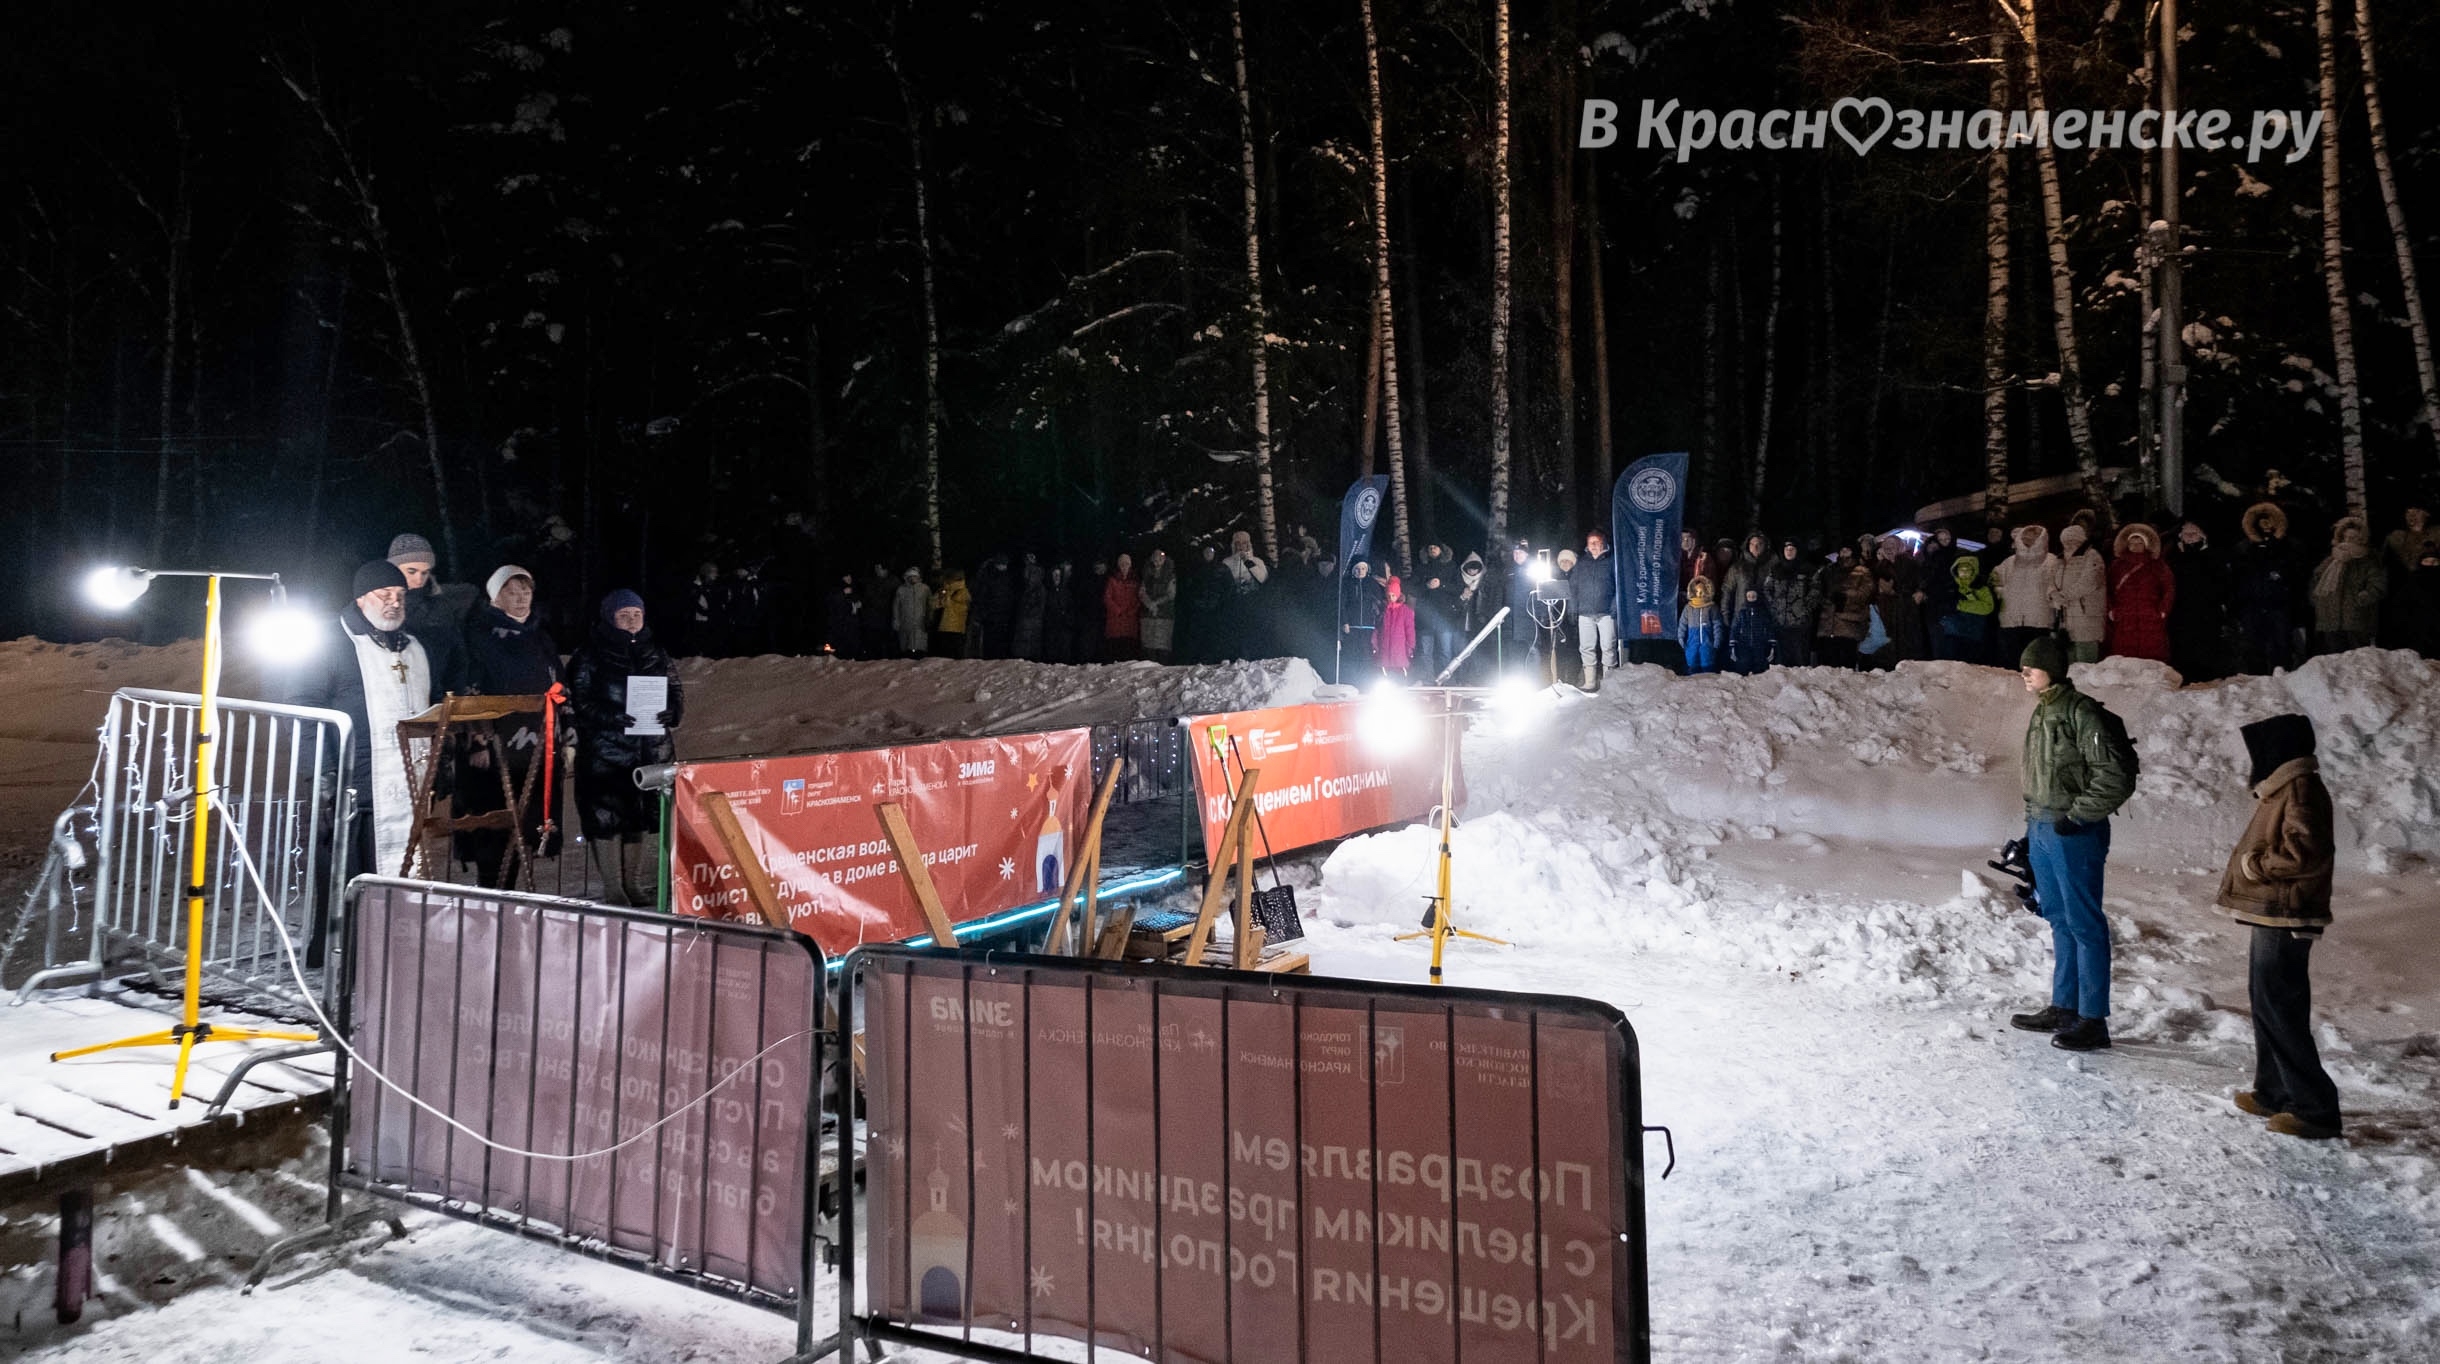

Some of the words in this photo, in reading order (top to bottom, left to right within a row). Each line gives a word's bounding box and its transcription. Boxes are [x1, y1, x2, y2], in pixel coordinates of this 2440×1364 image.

[1636, 582, 1649, 604] Клуб
[1217, 784, 1312, 822] Кщением
[1314, 764, 1393, 802] Господним!
[692, 861, 740, 888] Пус
[833, 870, 843, 885] в
[845, 862, 886, 886] доме
[938, 842, 979, 866] царит
[787, 893, 825, 924] уют!
